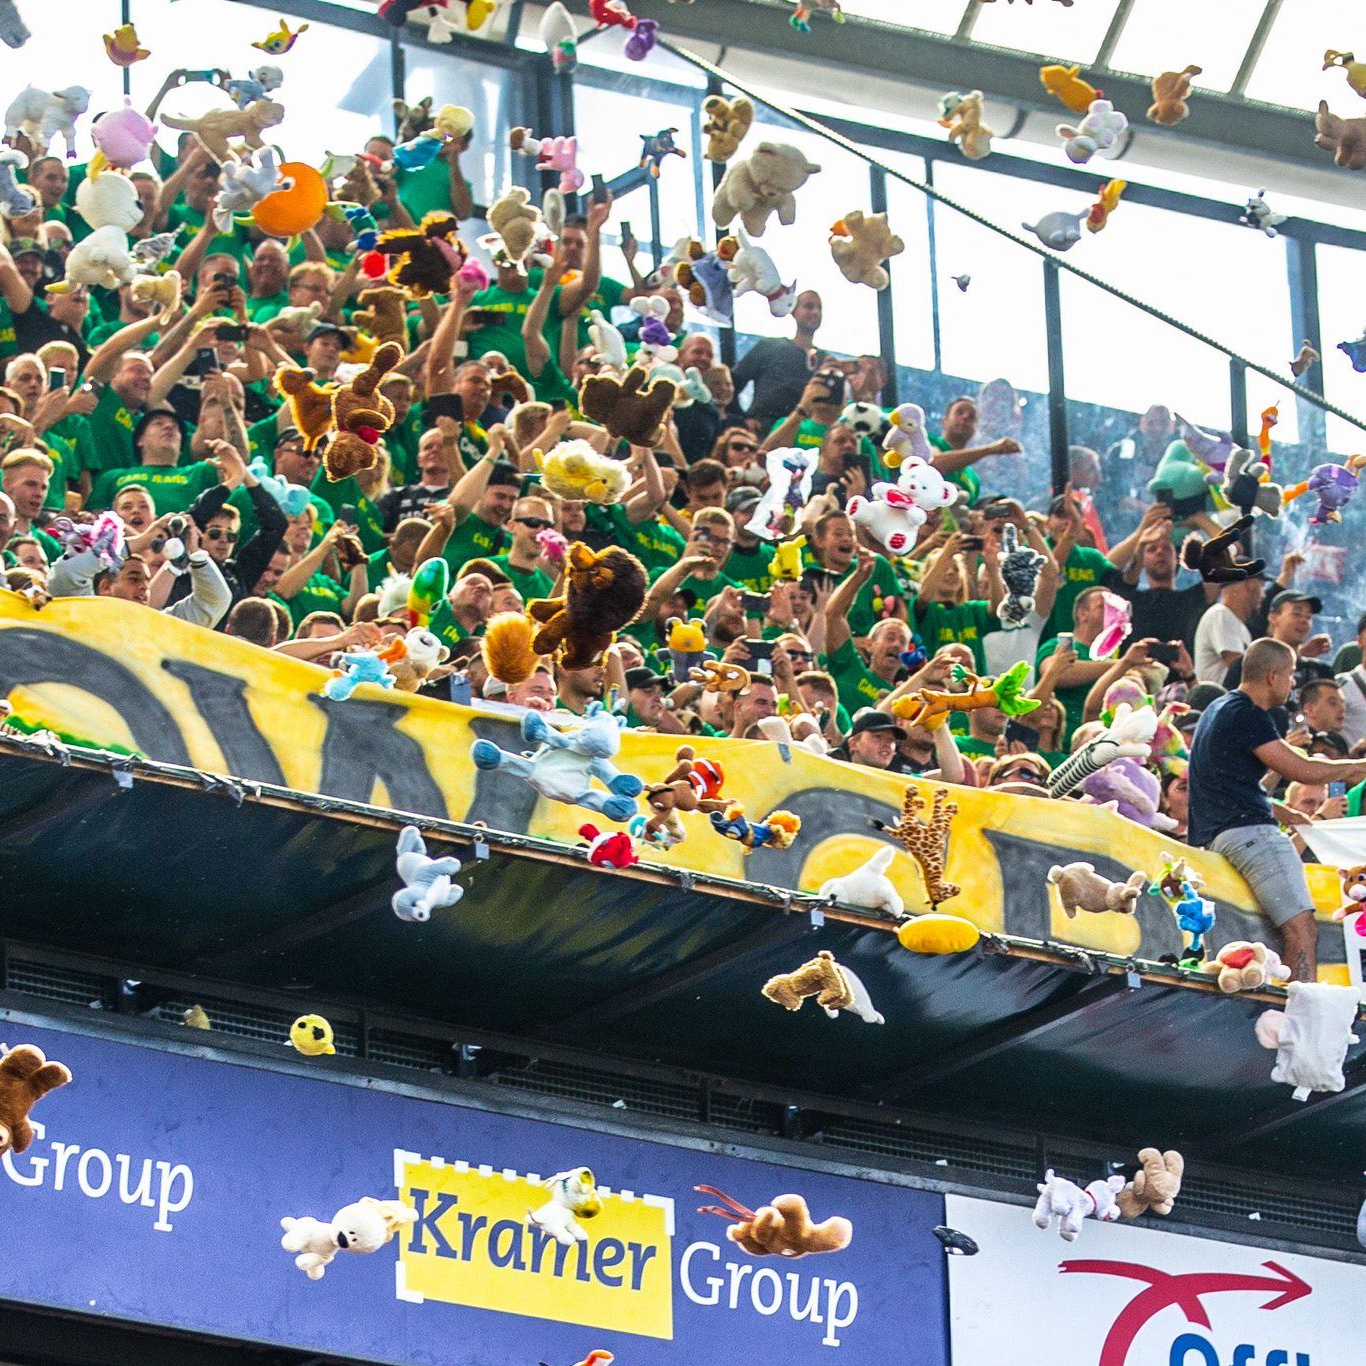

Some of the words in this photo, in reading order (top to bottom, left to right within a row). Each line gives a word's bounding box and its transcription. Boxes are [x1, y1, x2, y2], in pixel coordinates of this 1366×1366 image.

[4, 1119, 194, 1232] Group
[409, 1187, 656, 1291] Kramer
[680, 1240, 859, 1347] Group
